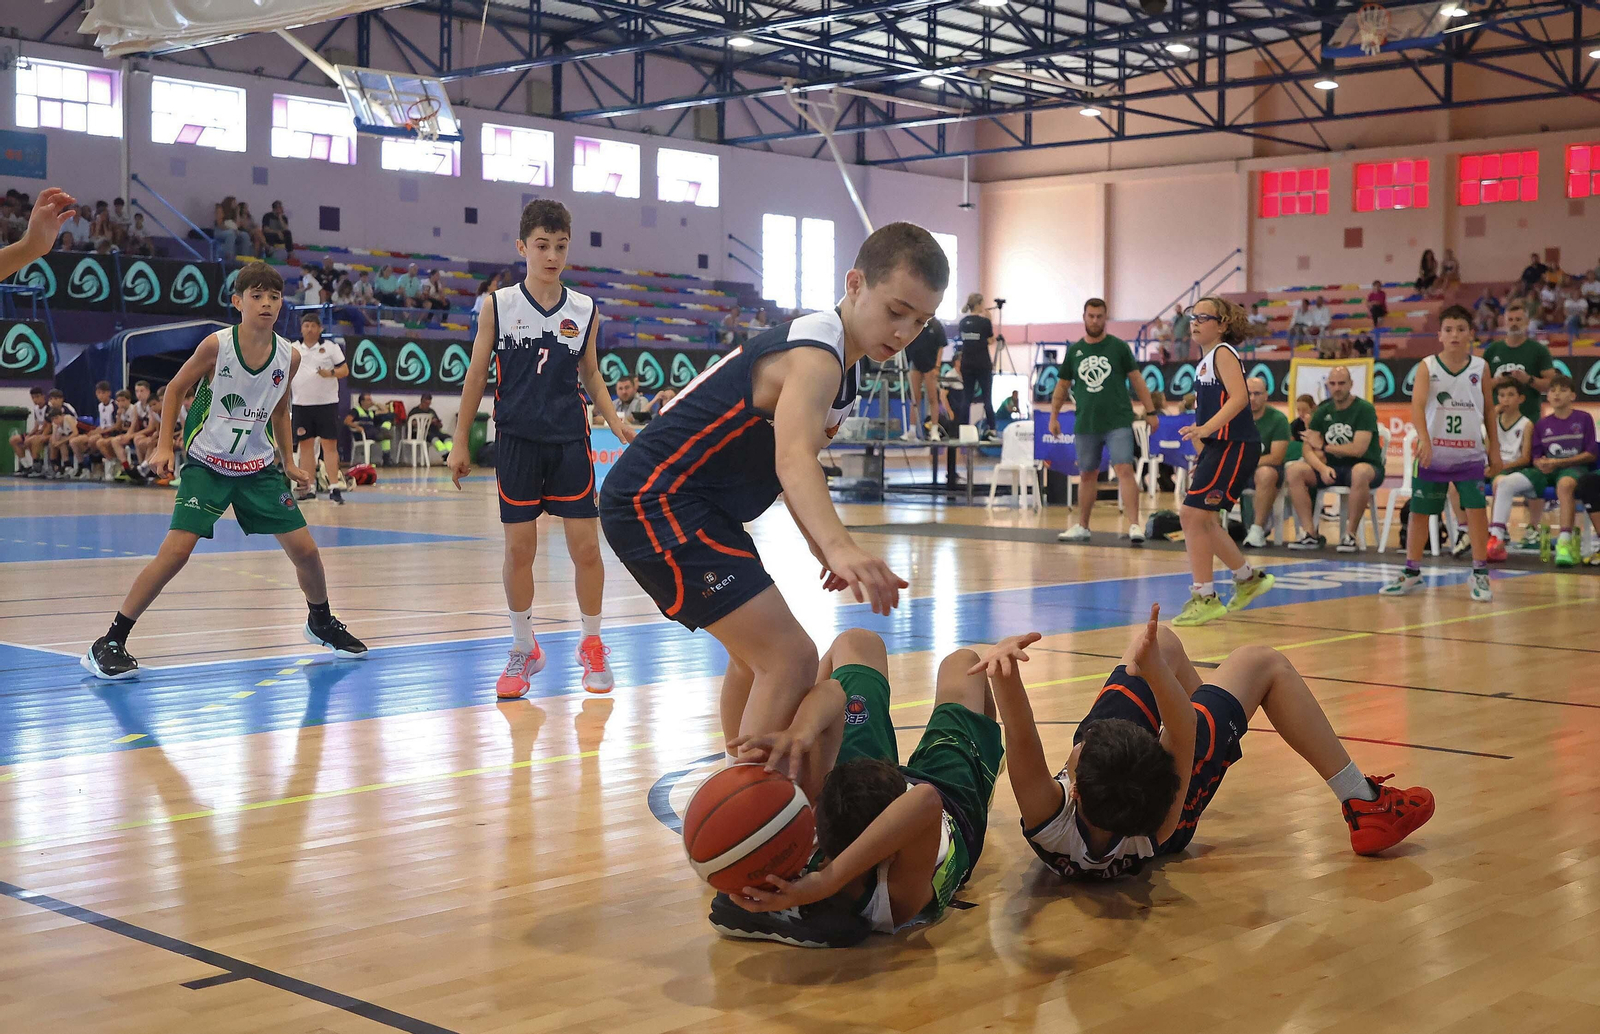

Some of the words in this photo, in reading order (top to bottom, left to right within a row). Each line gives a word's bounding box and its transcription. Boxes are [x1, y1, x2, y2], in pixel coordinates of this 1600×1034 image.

[536, 347, 550, 375] 7
[1078, 355, 1111, 373] EBG
[1446, 415, 1462, 434] 32
[1042, 432, 1076, 444] moten
[1054, 857, 1133, 879] GOALO
